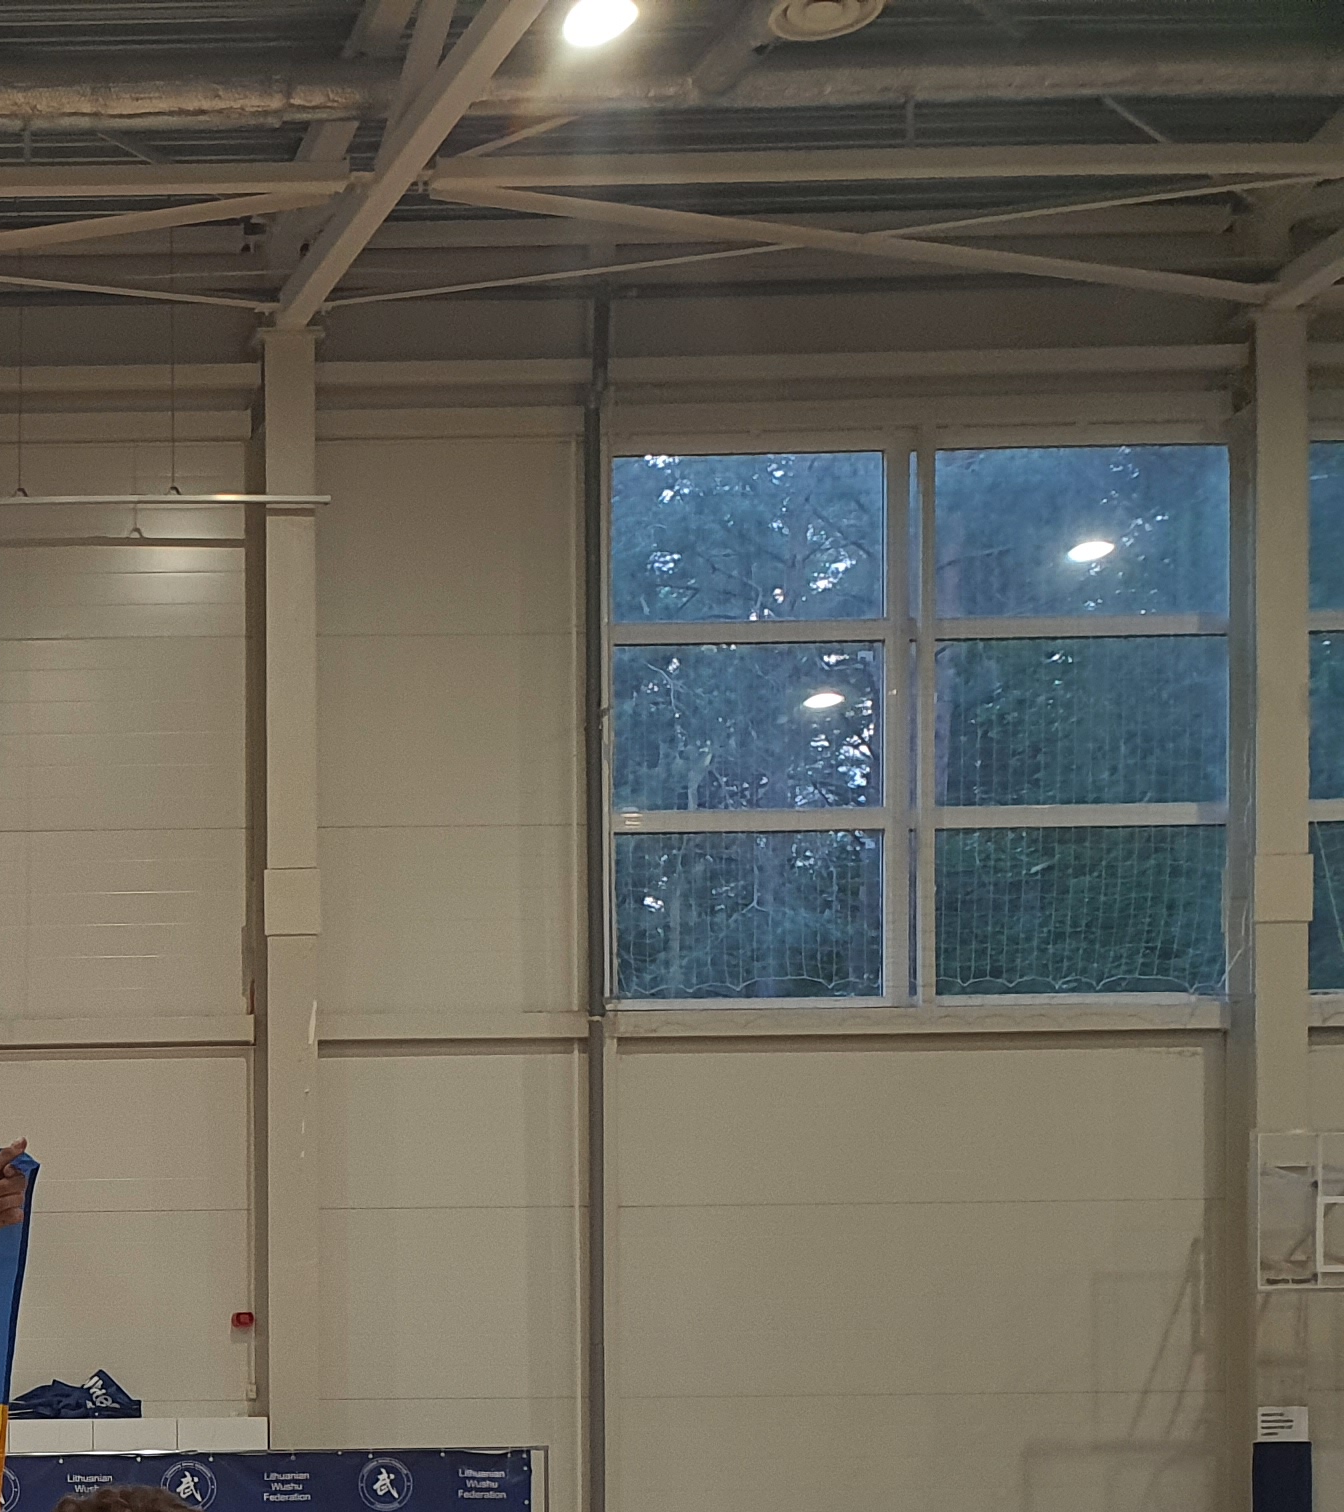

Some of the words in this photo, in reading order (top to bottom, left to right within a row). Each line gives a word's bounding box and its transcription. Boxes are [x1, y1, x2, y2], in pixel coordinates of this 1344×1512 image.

[67, 1473, 113, 1483] Lithuanian
[264, 1471, 310, 1481] Lithuanian
[458, 1468, 505, 1478] Lithuanian
[271, 1482, 303, 1490] Wushu
[466, 1479, 498, 1488] Wushu
[263, 1492, 311, 1502] Federation
[457, 1489, 507, 1499] Federation
